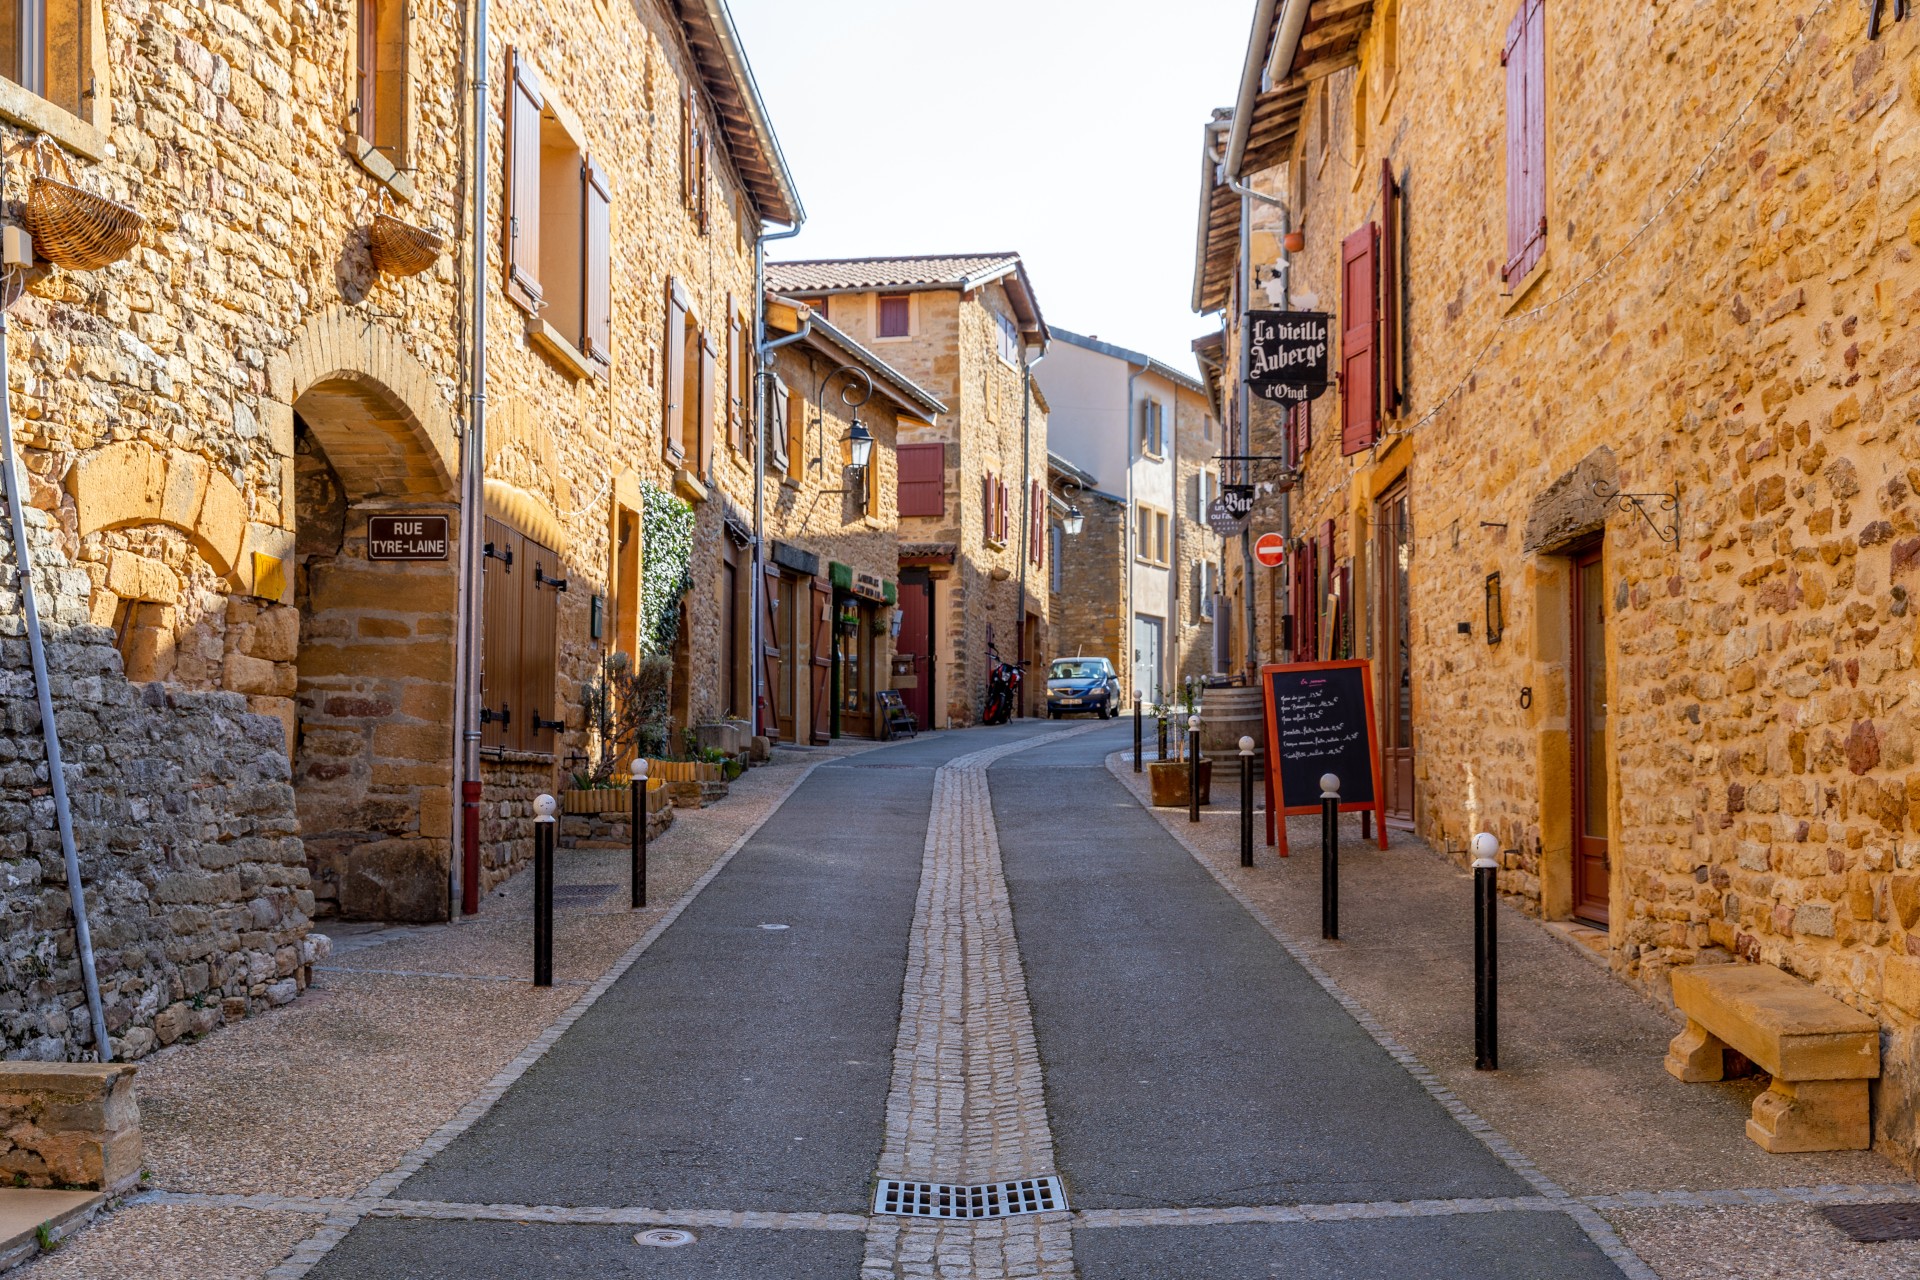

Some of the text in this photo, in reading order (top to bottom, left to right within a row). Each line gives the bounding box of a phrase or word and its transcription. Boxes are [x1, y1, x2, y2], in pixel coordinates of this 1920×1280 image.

[1252, 320, 1326, 345] La vieille
[1250, 342, 1326, 379] Auberge
[1265, 384, 1308, 400] d'Oingt
[1225, 493, 1253, 512] Bar
[394, 522, 423, 535] RUE
[372, 540, 444, 553] TYRE-LAINE
